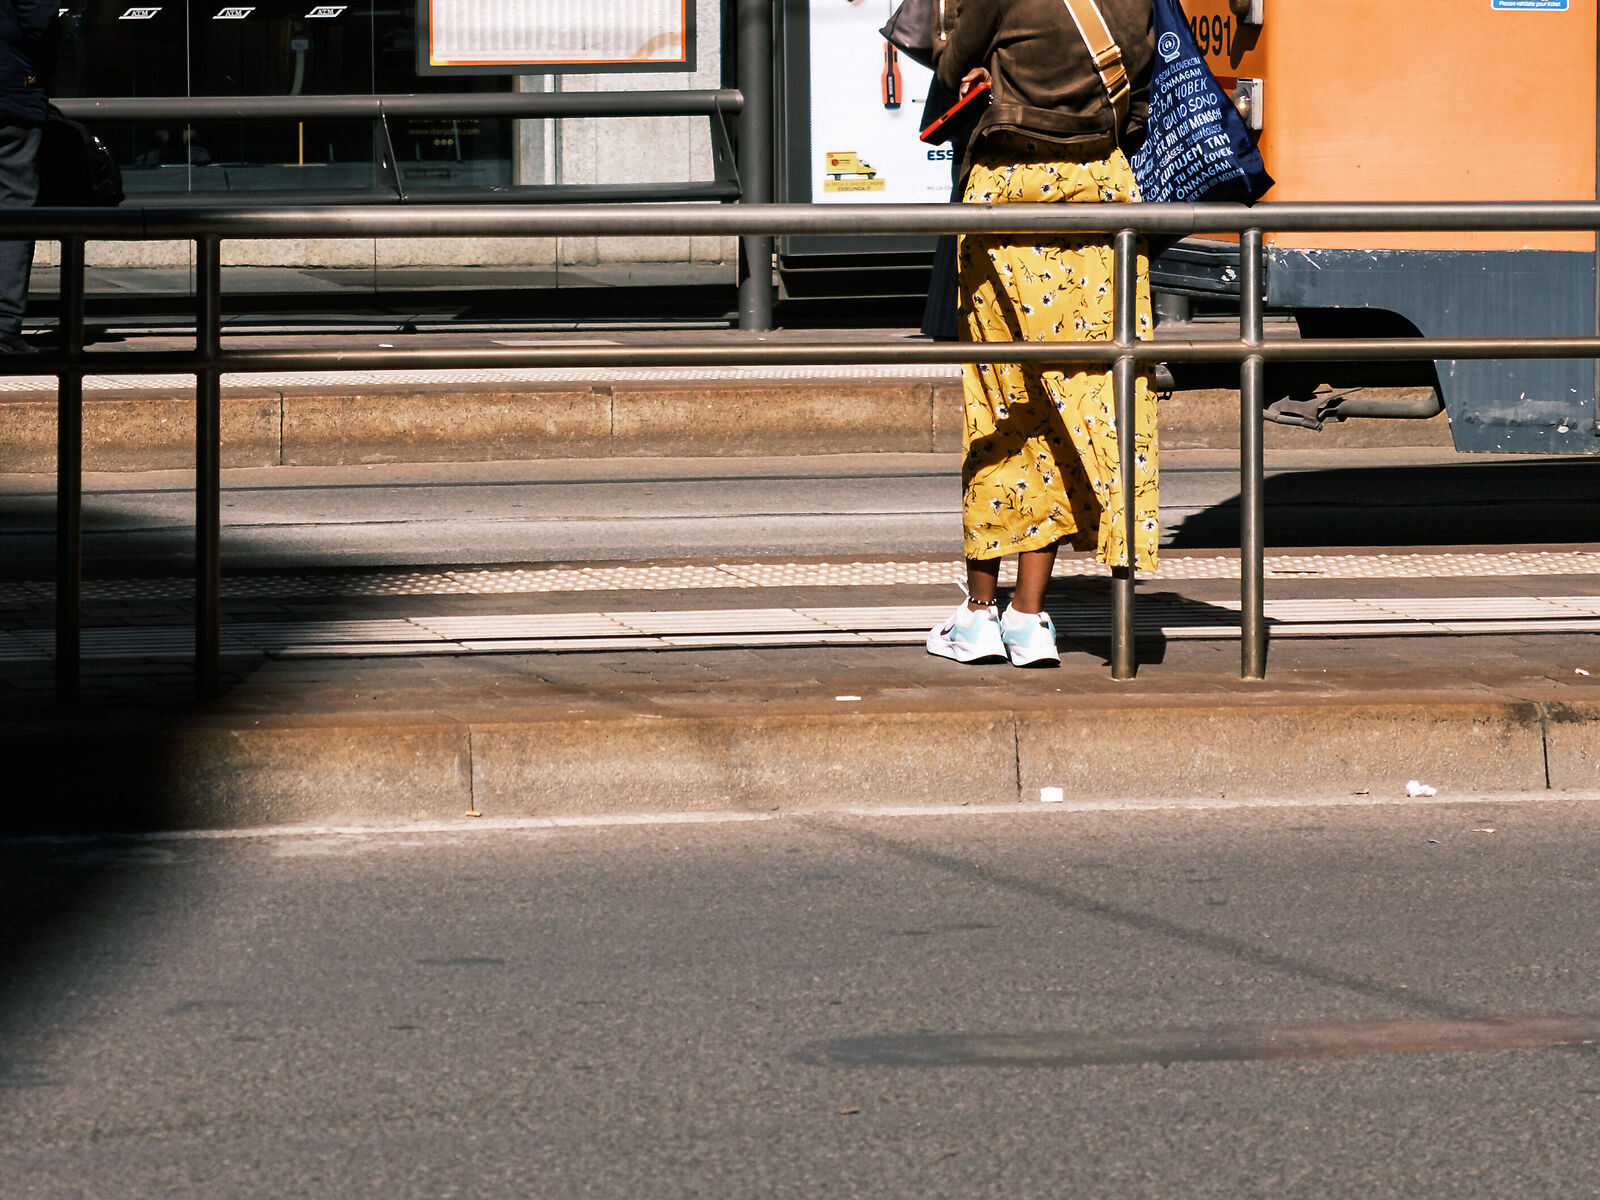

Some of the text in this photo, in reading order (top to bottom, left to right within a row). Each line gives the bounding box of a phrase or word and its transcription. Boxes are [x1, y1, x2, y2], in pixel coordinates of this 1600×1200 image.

[1188, 92, 1218, 112] SONO
[1188, 108, 1223, 130] MENSCH
[1160, 143, 1203, 186] KUPUJEM
[1204, 132, 1231, 149] TAM
[1174, 172, 1187, 185] TU
[1187, 160, 1204, 177] SAM
[1175, 159, 1232, 200] ÖNMAGAM
